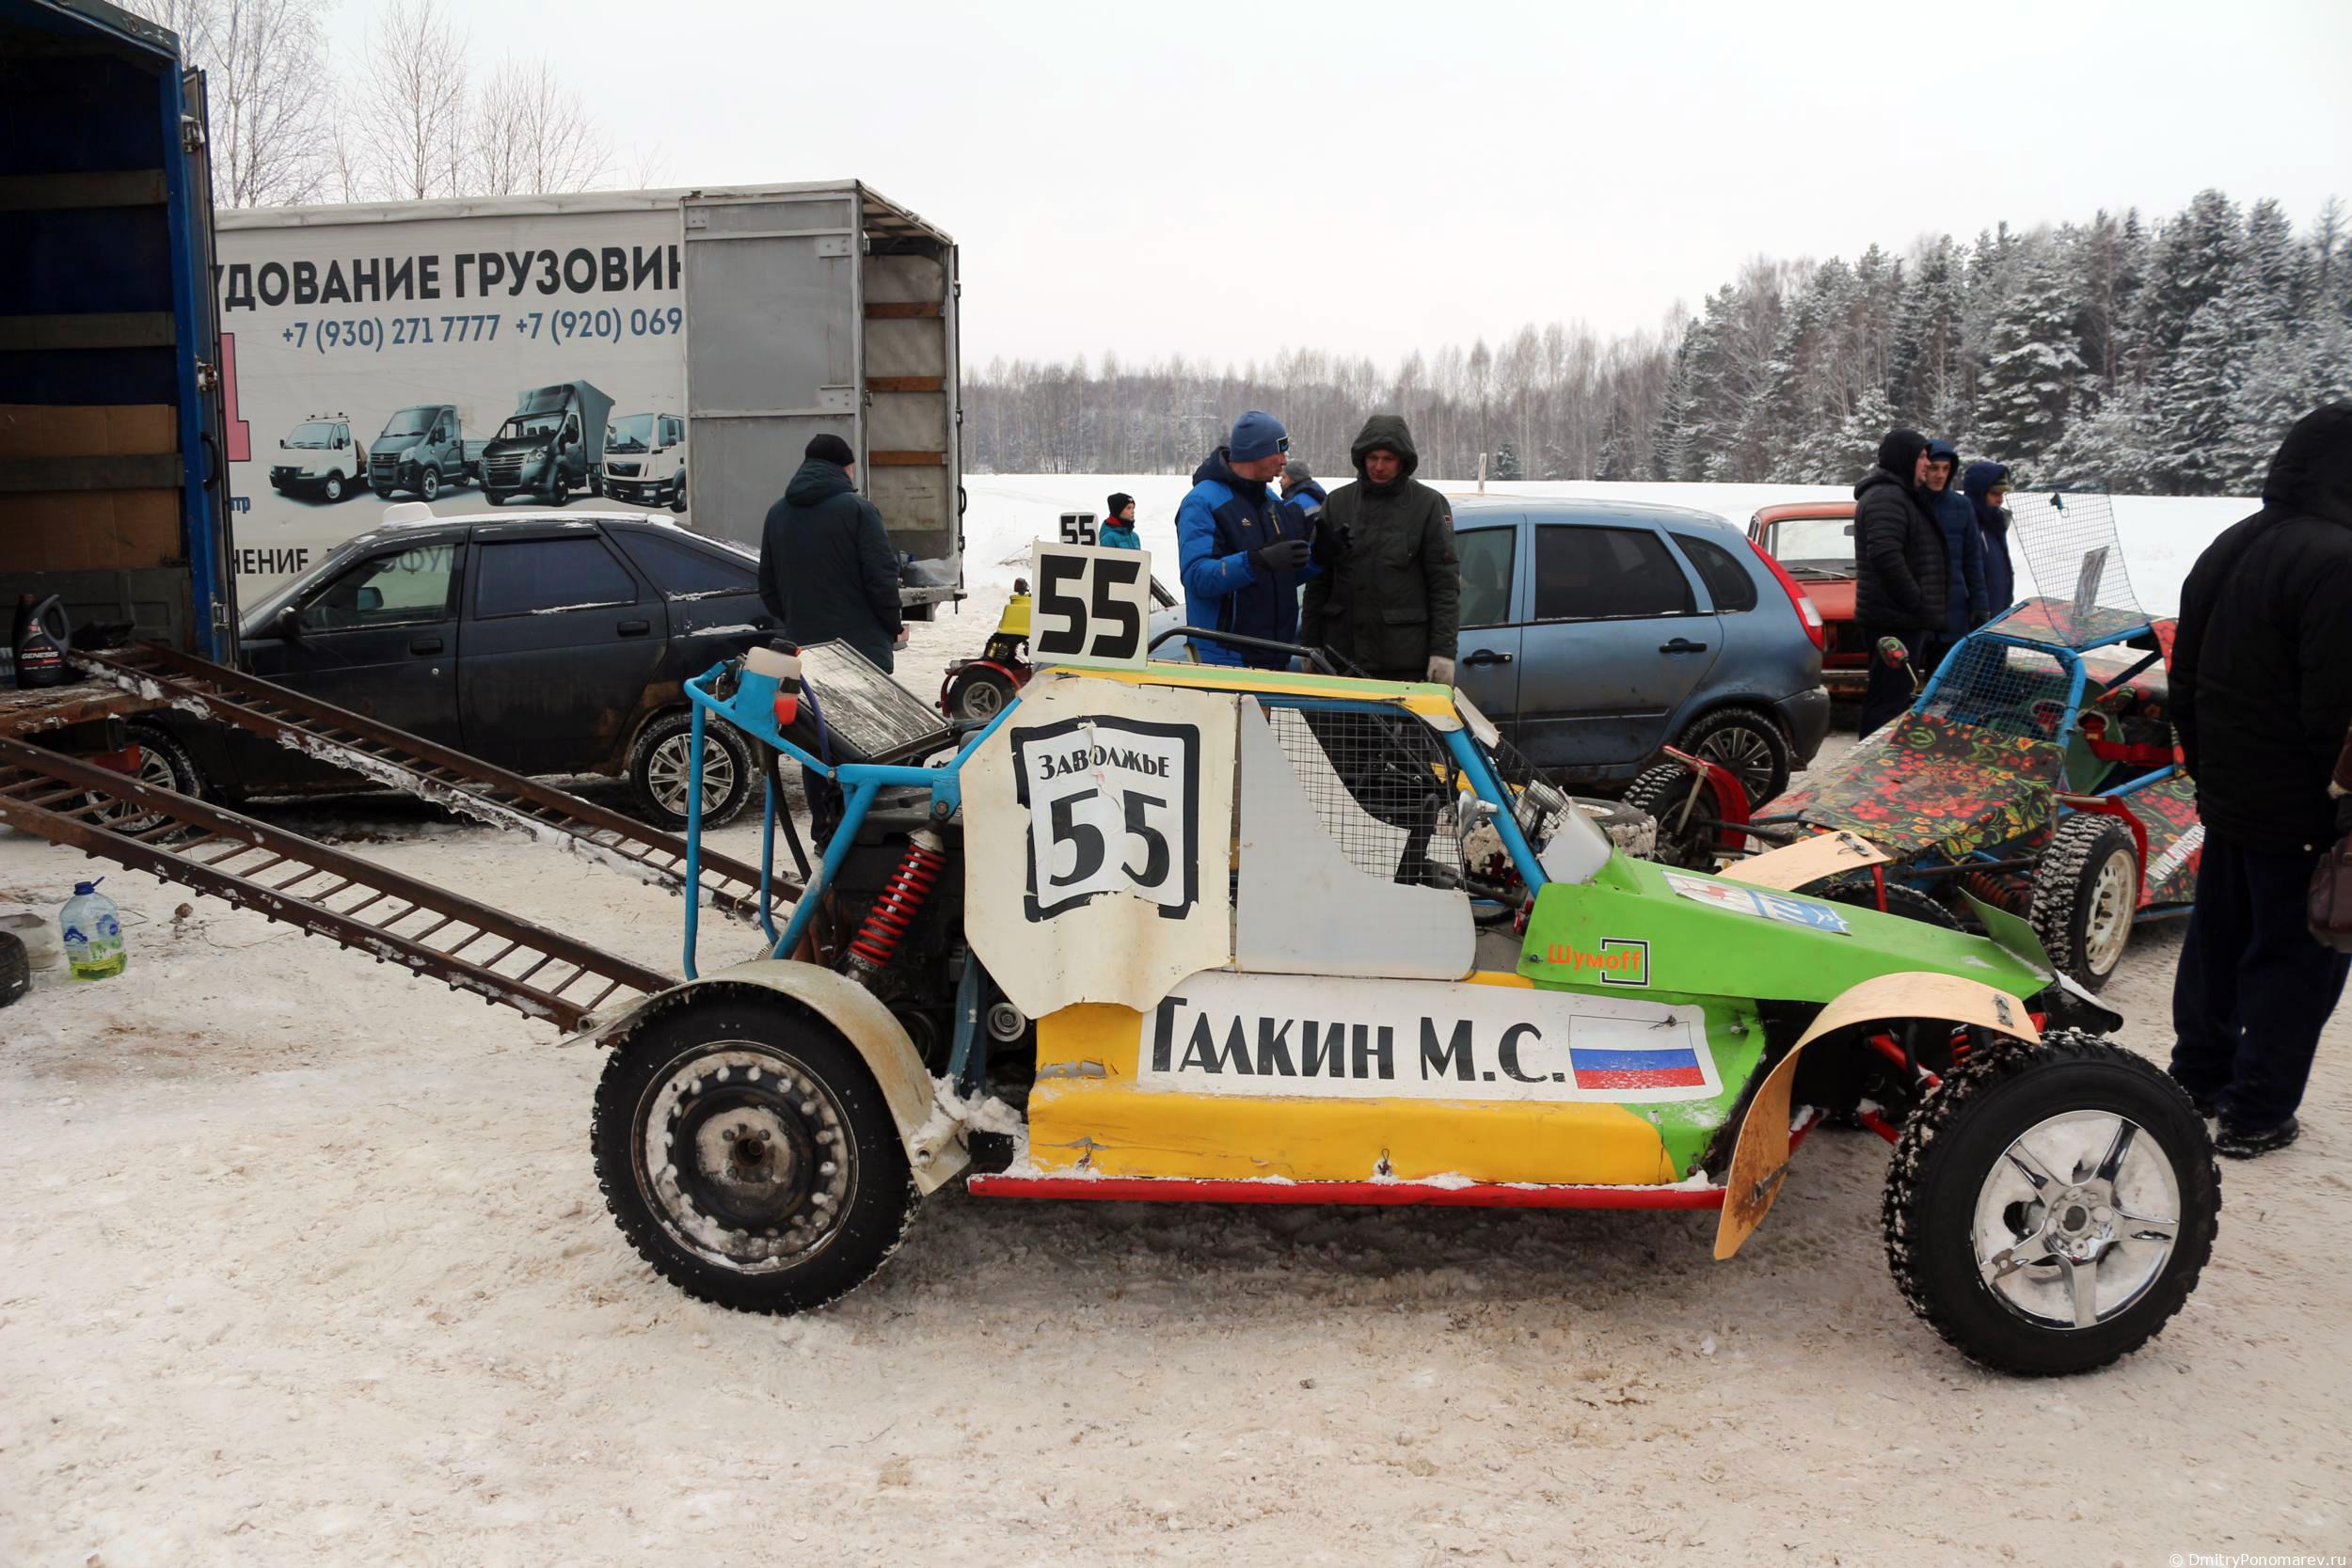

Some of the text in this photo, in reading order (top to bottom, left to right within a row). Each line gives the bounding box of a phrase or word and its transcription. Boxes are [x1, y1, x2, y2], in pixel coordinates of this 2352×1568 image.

[282, 307, 683, 355] +7 (930) 271 7777 +7 (920) 069
[1060, 515, 1096, 546] 55
[1037, 554, 1141, 658] 55
[22, 651, 59, 660] GENESIS
[1038, 745, 1170, 781] ЗАВОЛЖЬЕ
[1049, 787, 1170, 888] 55
[1549, 943, 1642, 971] Шумоff
[1152, 995, 1566, 1084] ГАЛКИН М.С.
